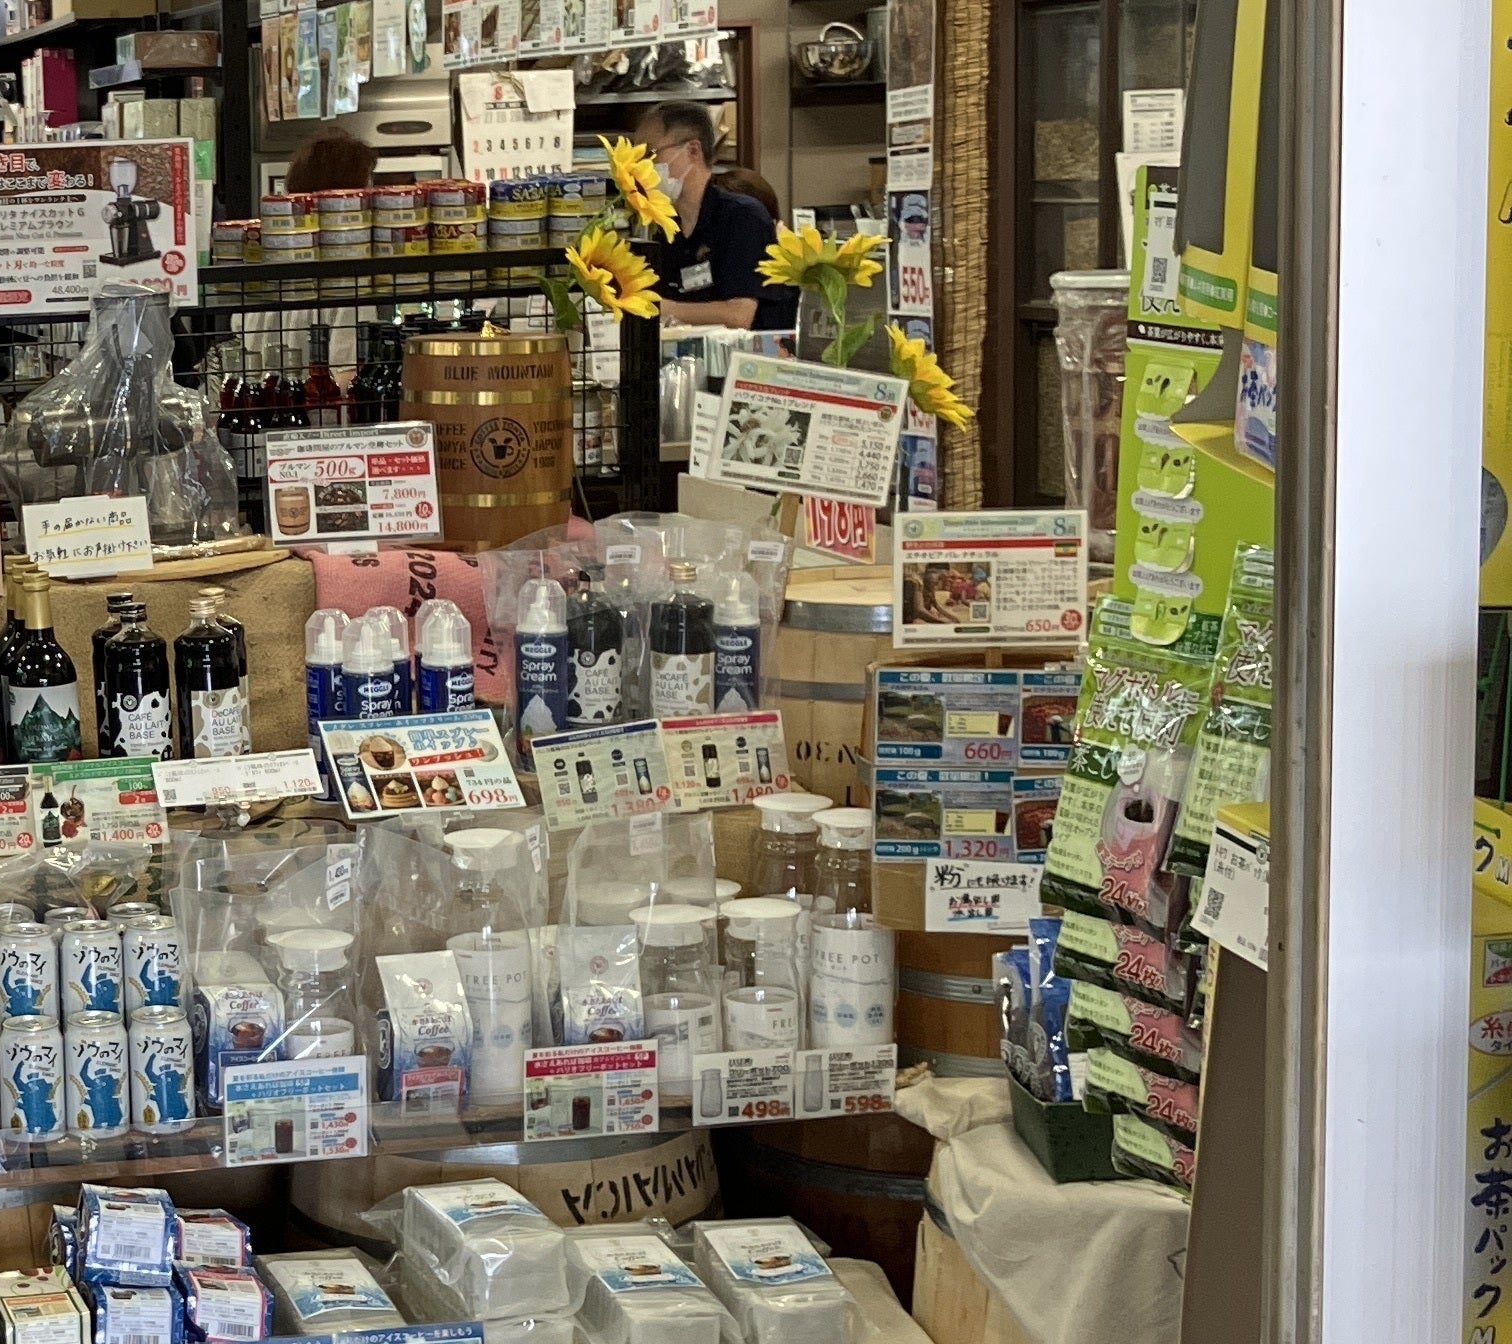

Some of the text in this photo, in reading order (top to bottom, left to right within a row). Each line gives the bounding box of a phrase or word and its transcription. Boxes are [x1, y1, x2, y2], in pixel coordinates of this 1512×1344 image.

[487, 139, 492, 152] 3
[500, 139, 506, 151] 4
[525, 137, 531, 150] 6
[539, 137, 544, 149] 7
[444, 366, 478, 381] BLUE
[41, 511, 131, 535] 手の届かない商品
[717, 652, 751, 667] Spray
[522, 659, 556, 674] Spray
[716, 662, 752, 675] Cream
[521, 670, 557, 682] Cream
[129, 719, 165, 731] AU LAIT
[212, 718, 225, 727] AU
[129, 731, 155, 740] BASE
[212, 726, 235, 737] BASE
[468, 788, 518, 804] 698円
[850, 952, 880, 965] POT
